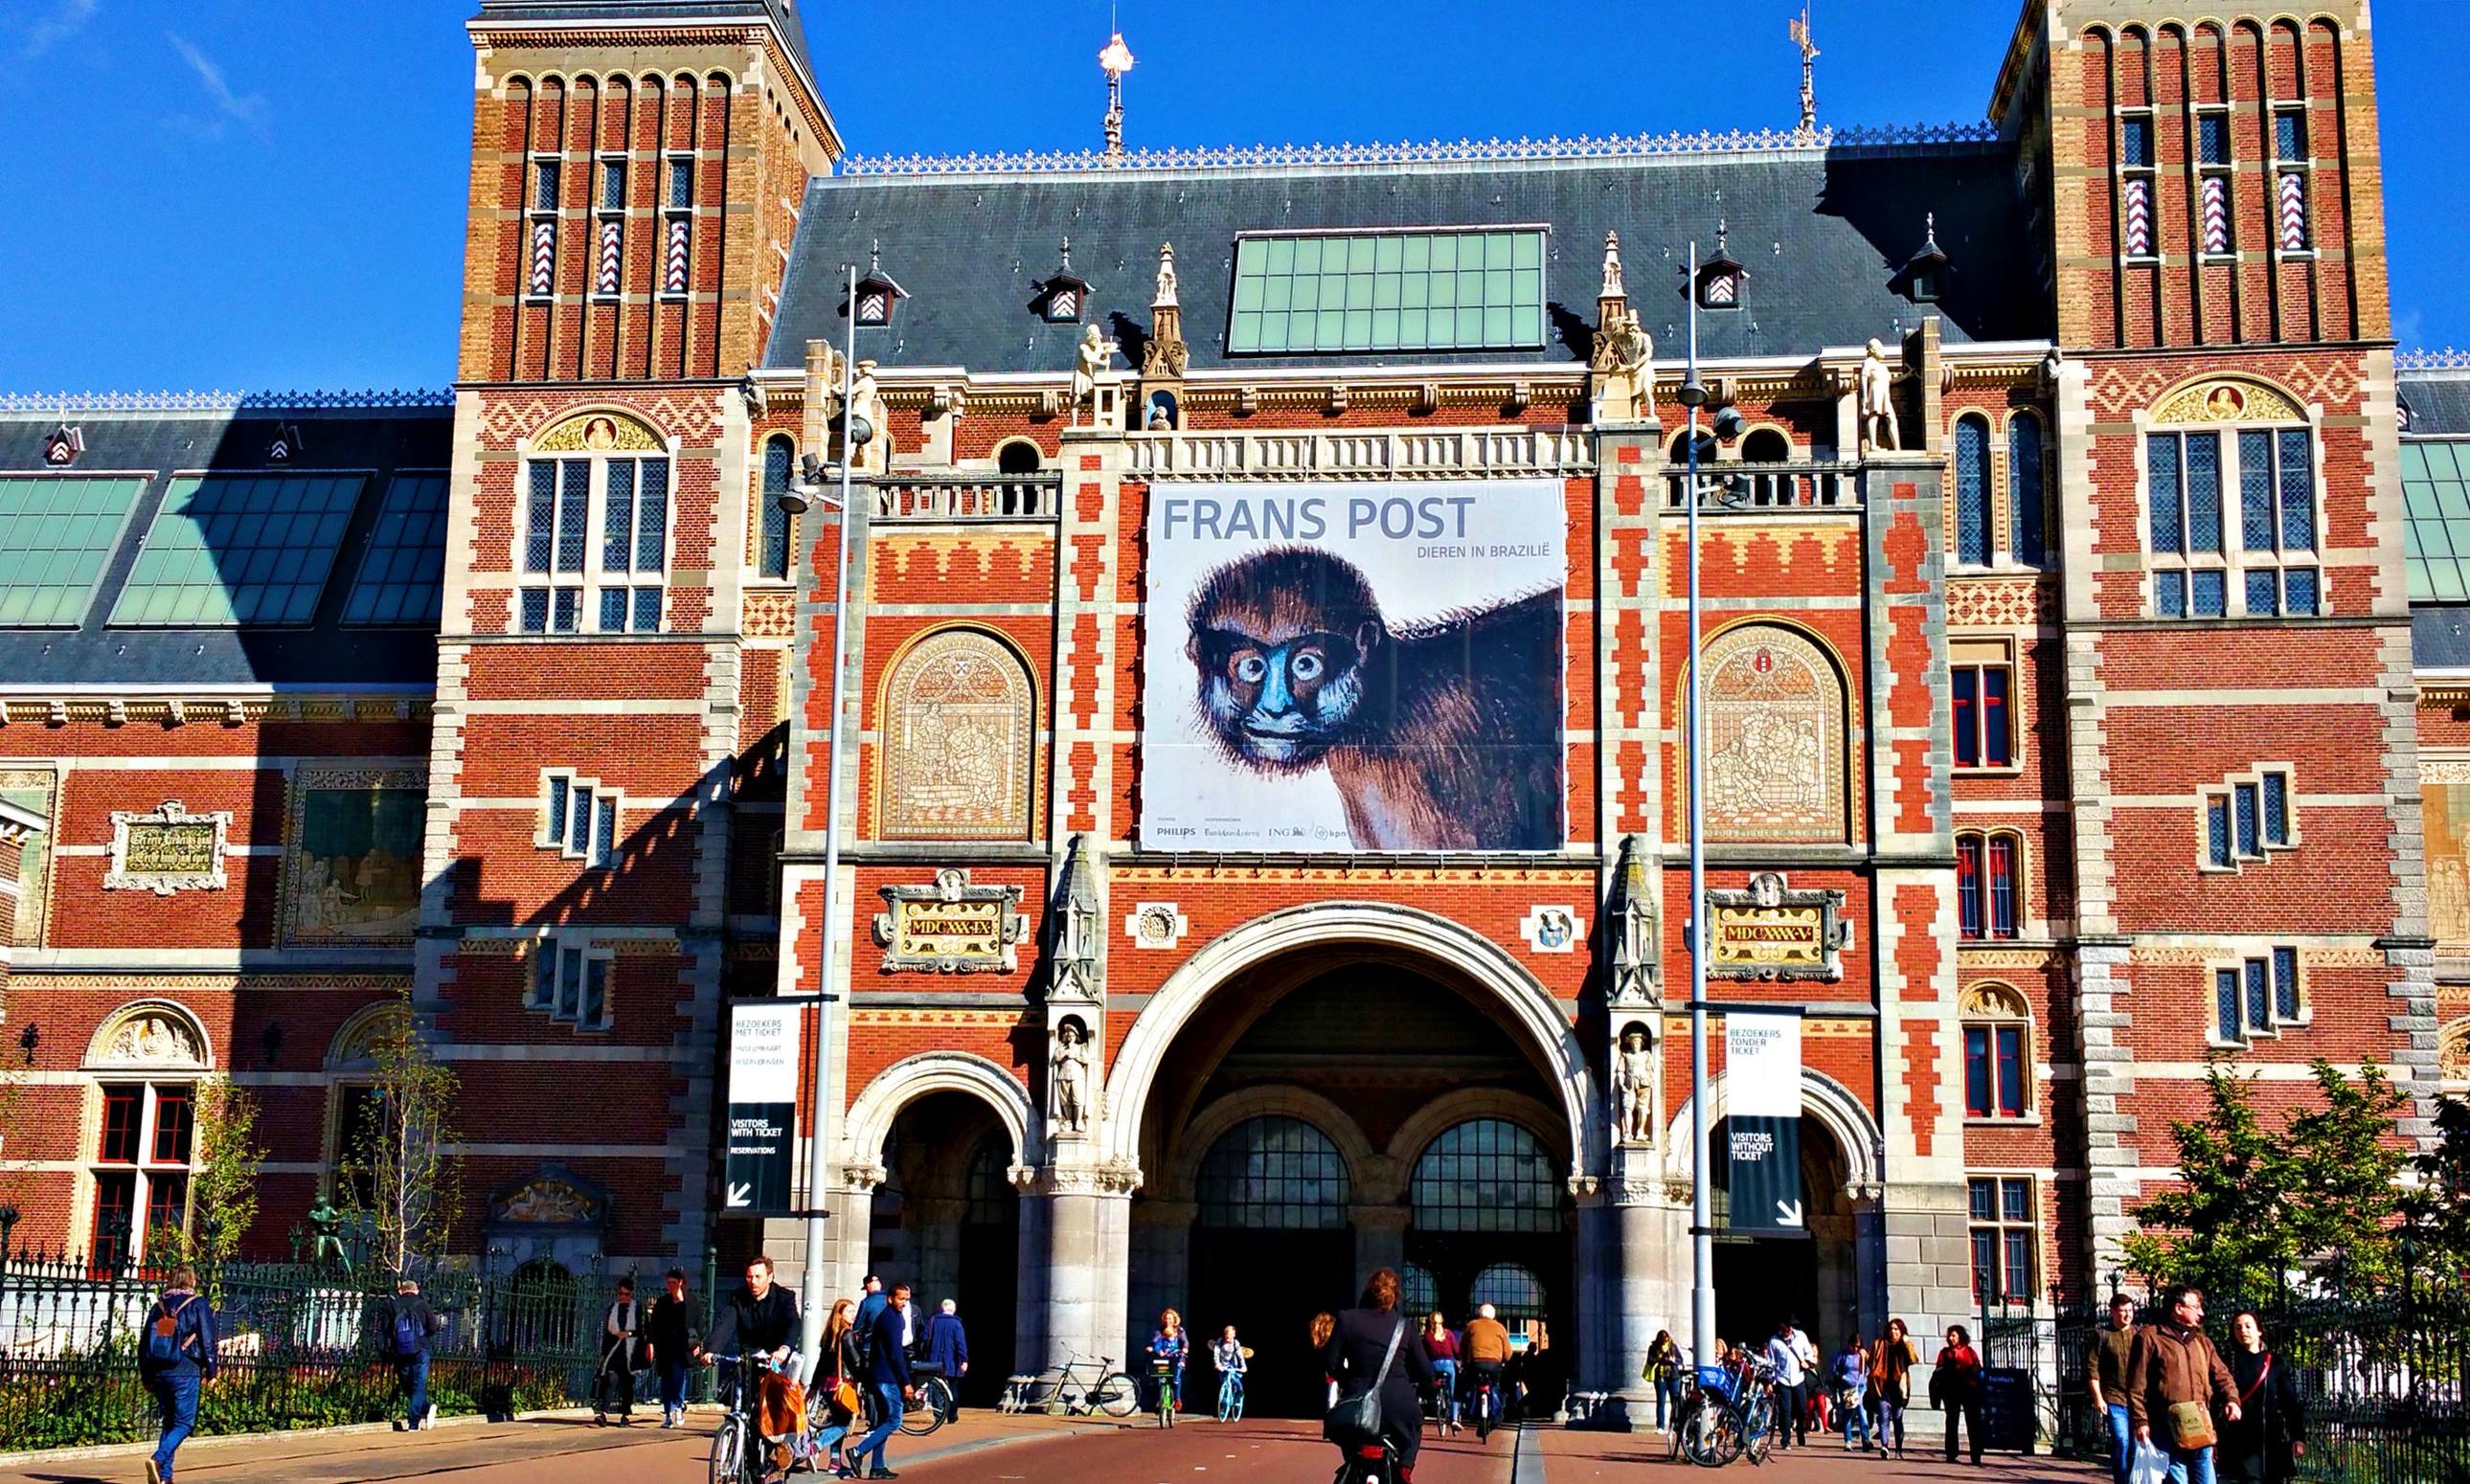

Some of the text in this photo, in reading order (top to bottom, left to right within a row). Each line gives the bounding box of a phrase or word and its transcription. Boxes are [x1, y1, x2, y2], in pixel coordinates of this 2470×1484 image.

[1163, 497, 1476, 540] FRANS POST
[1417, 542, 1551, 559] DIEREN IN BRAZILIË
[1157, 827, 1196, 837] PHILIPS
[1268, 828, 1290, 837] ING
[736, 1020, 782, 1028] BEZOEKERS
[1730, 1029, 1781, 1038] BEZOEKERS
[1730, 1038, 1767, 1046] ZONDER
[732, 1119, 768, 1128] VISITORS
[731, 1128, 782, 1137] WITH TICKET
[1731, 1133, 1772, 1142] VISITORS
[1731, 1142, 1774, 1152] WITHOUT
[1732, 1152, 1762, 1160] TICKET
